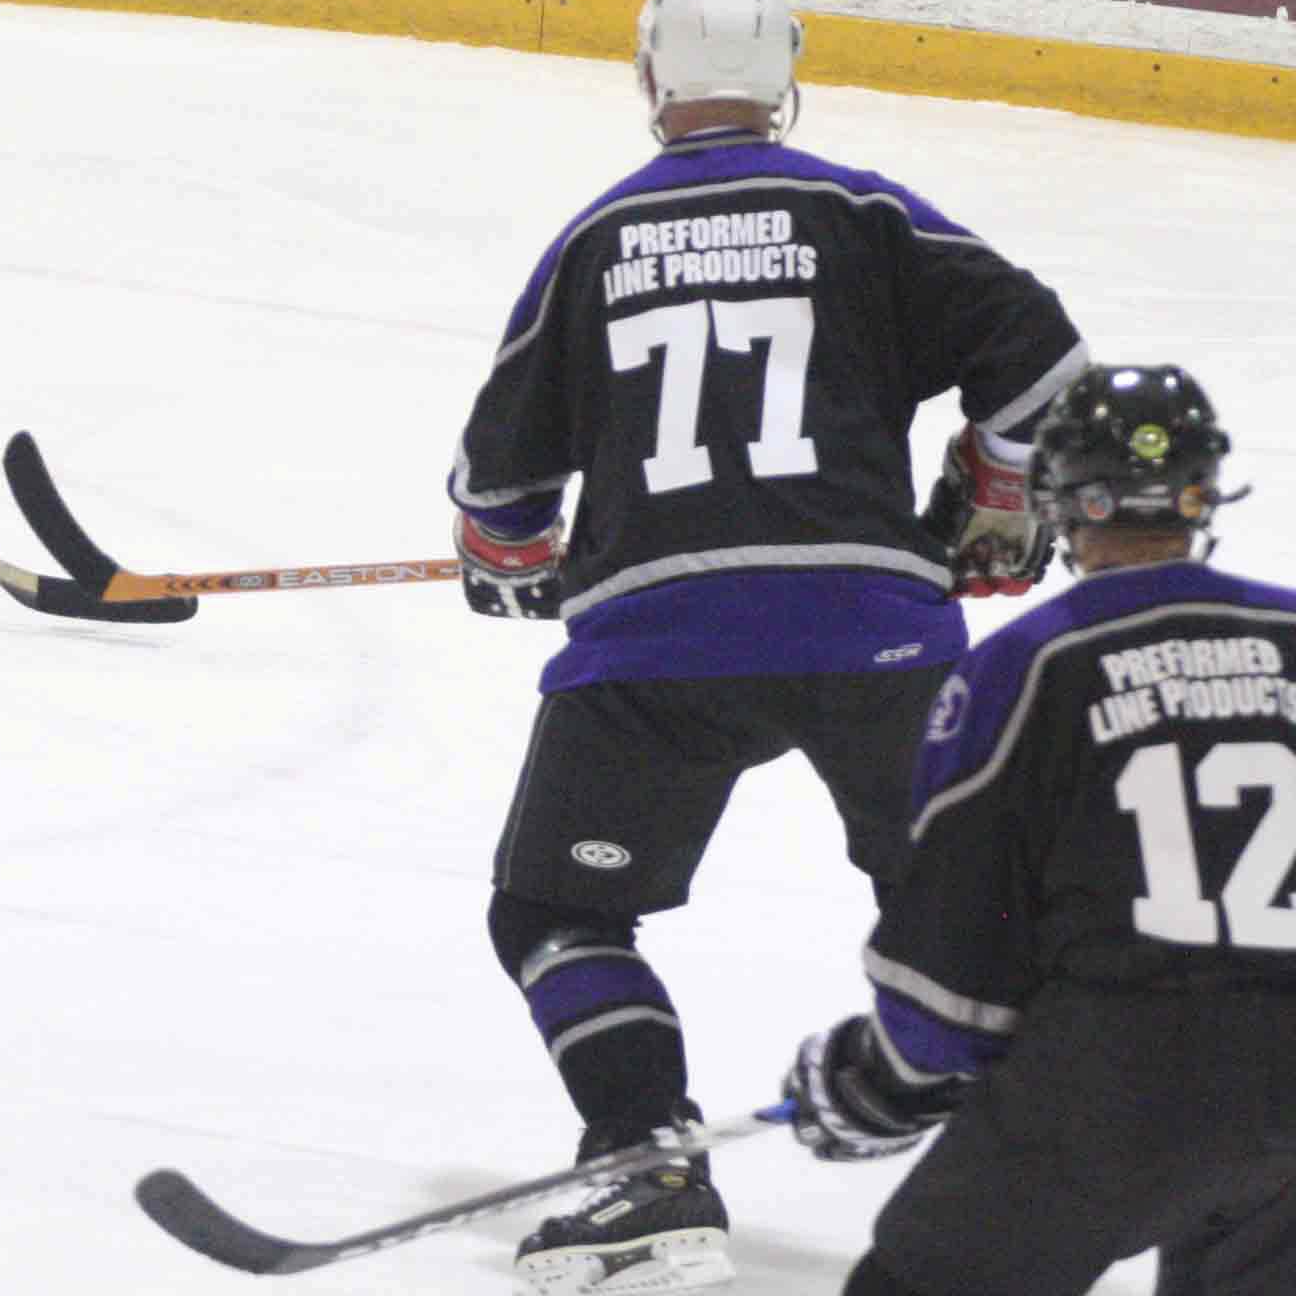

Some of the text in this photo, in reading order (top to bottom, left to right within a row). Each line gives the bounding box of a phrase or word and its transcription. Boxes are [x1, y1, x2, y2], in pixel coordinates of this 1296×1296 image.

[619, 209, 793, 259] PREFORMED
[603, 243, 817, 307] LINE PRODUCTS
[607, 296, 818, 494] 77
[276, 563, 427, 590] EASTON
[1115, 742, 1296, 949] 12
